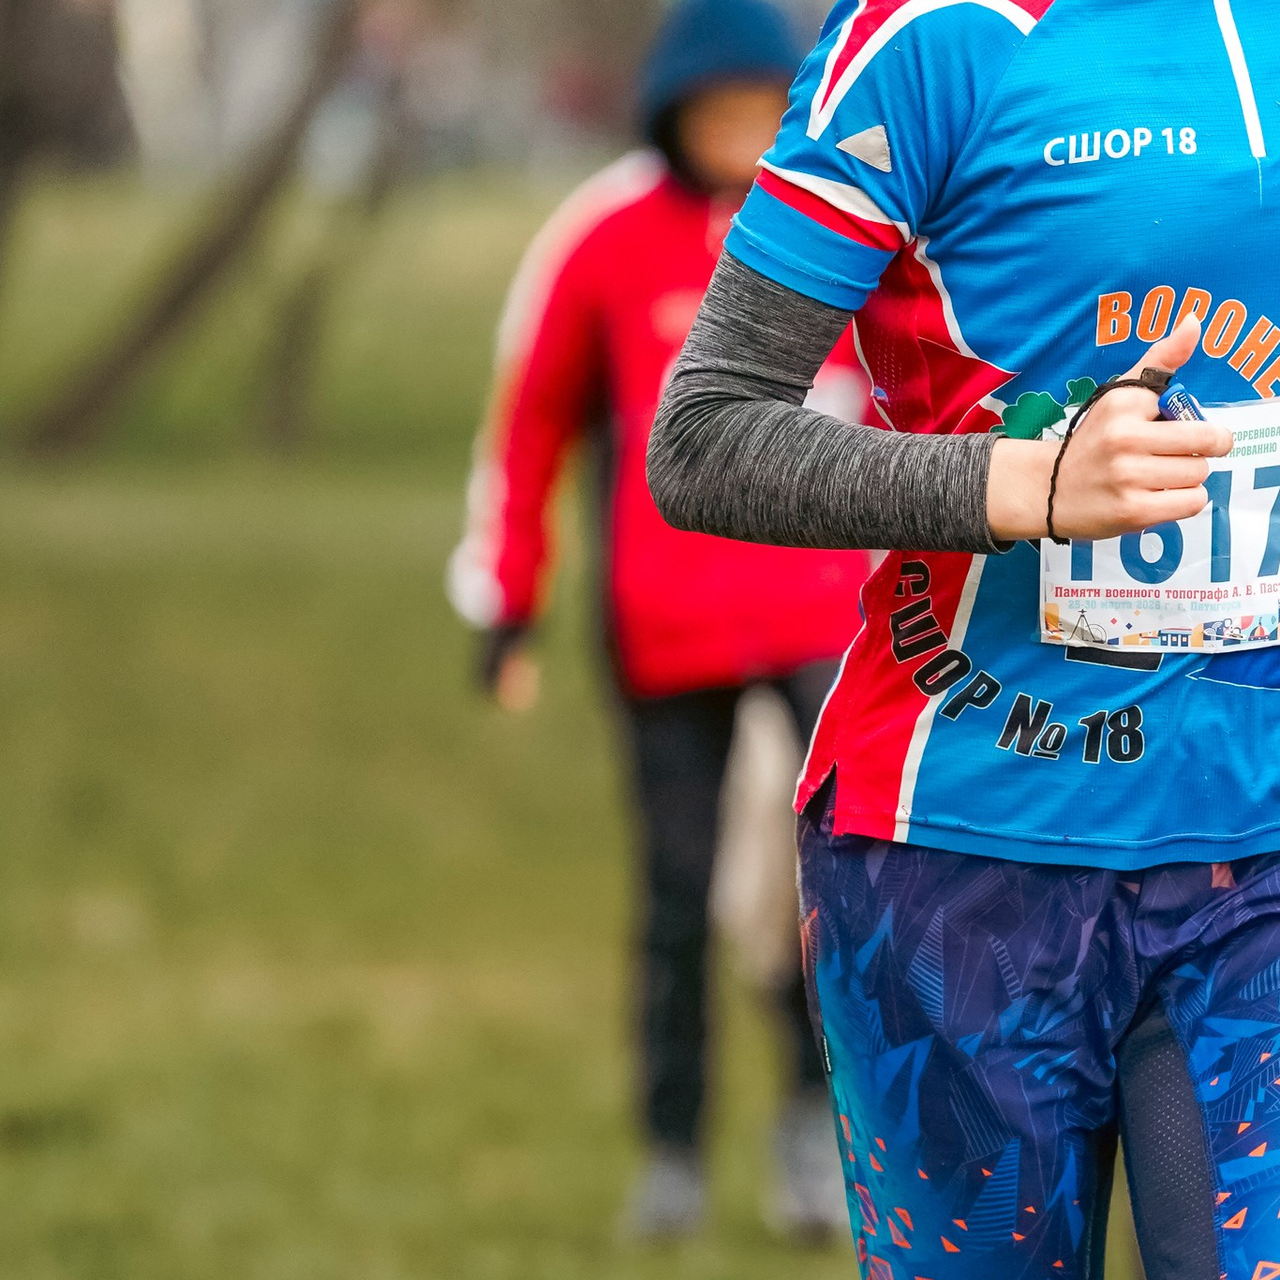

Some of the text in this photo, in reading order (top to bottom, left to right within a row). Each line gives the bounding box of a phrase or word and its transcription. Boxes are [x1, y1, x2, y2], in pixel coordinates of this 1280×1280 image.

[1043, 127, 1197, 167] СШОР 18
[1055, 587, 1100, 598] Памяти
[1105, 588, 1160, 599] военного
[1165, 588, 1228, 602] топографа
[890, 559, 1002, 721] СШОР
[1078, 705, 1145, 764] 18
